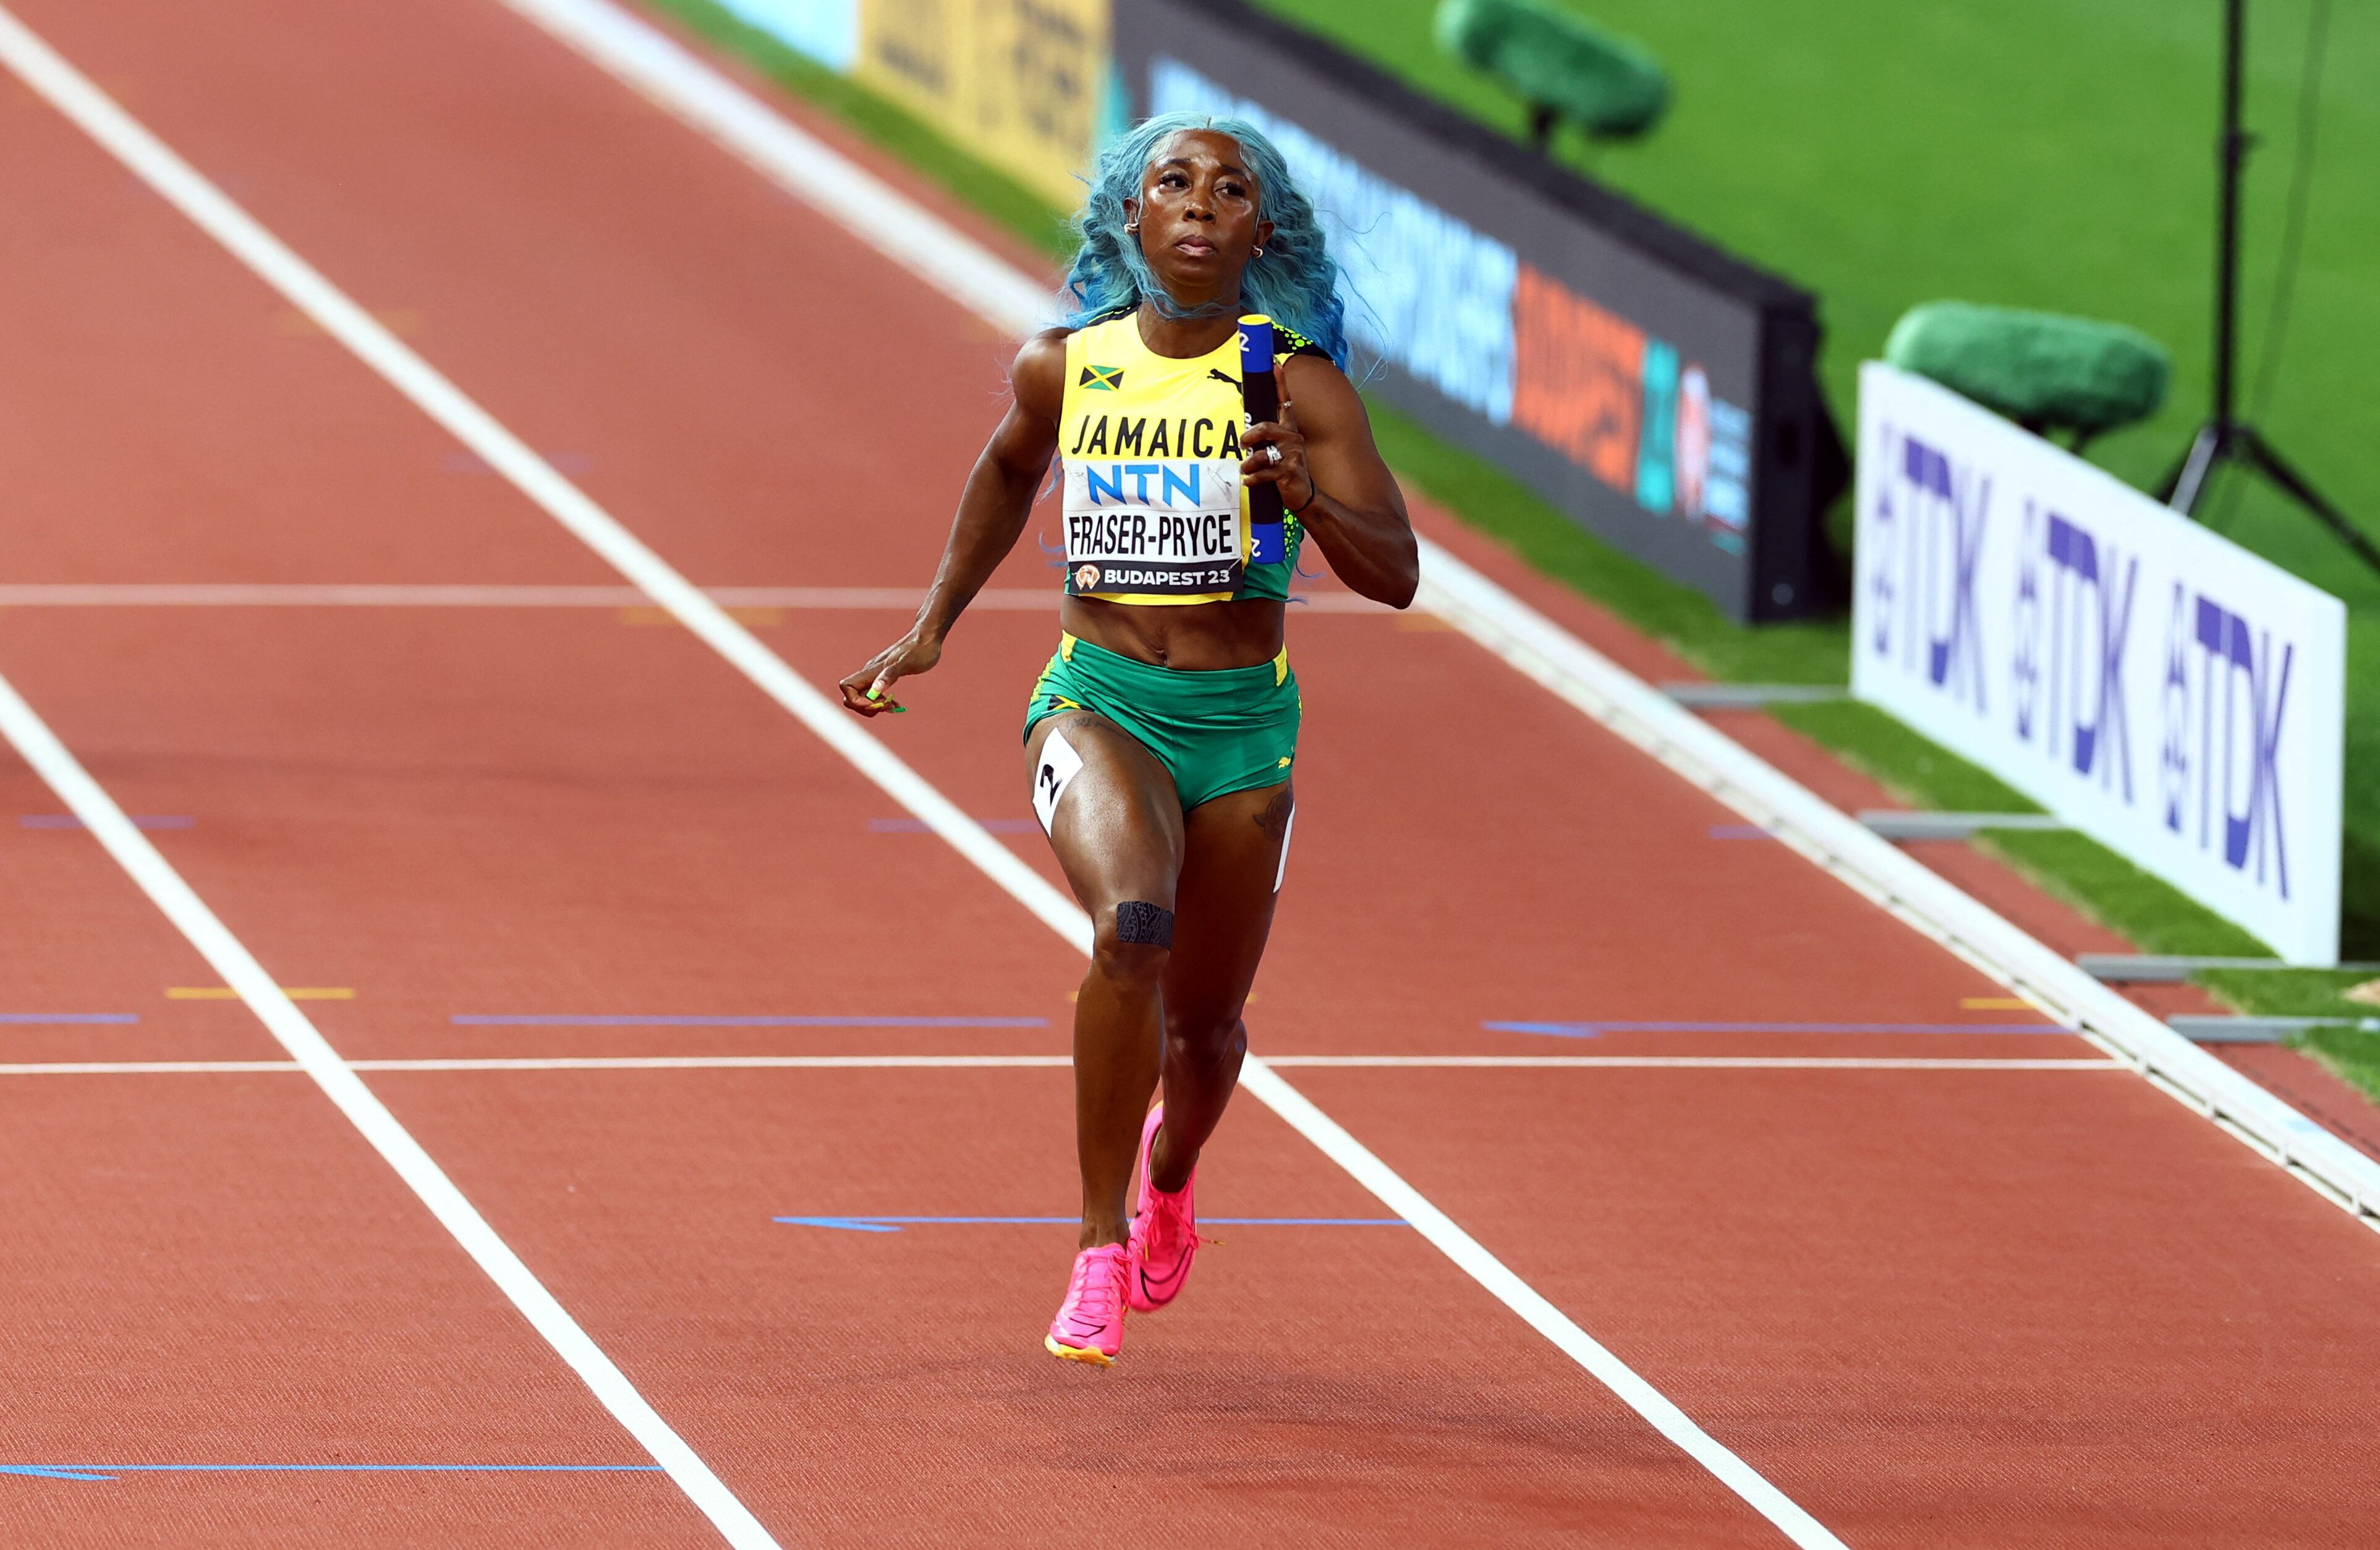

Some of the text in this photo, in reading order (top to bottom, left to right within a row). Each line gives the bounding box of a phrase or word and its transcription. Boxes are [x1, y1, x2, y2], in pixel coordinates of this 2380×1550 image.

[1239, 332, 1250, 352] 2
[1071, 415, 1243, 461] JAMAICA
[1086, 464, 1201, 508] NTN
[1069, 514, 1233, 556] FRASER-PRYCE
[1104, 569, 1230, 586] BUDAPEST 23
[1904, 435, 1993, 716] TDK
[2046, 511, 2139, 806] TDK
[2195, 594, 2295, 903] TDK
